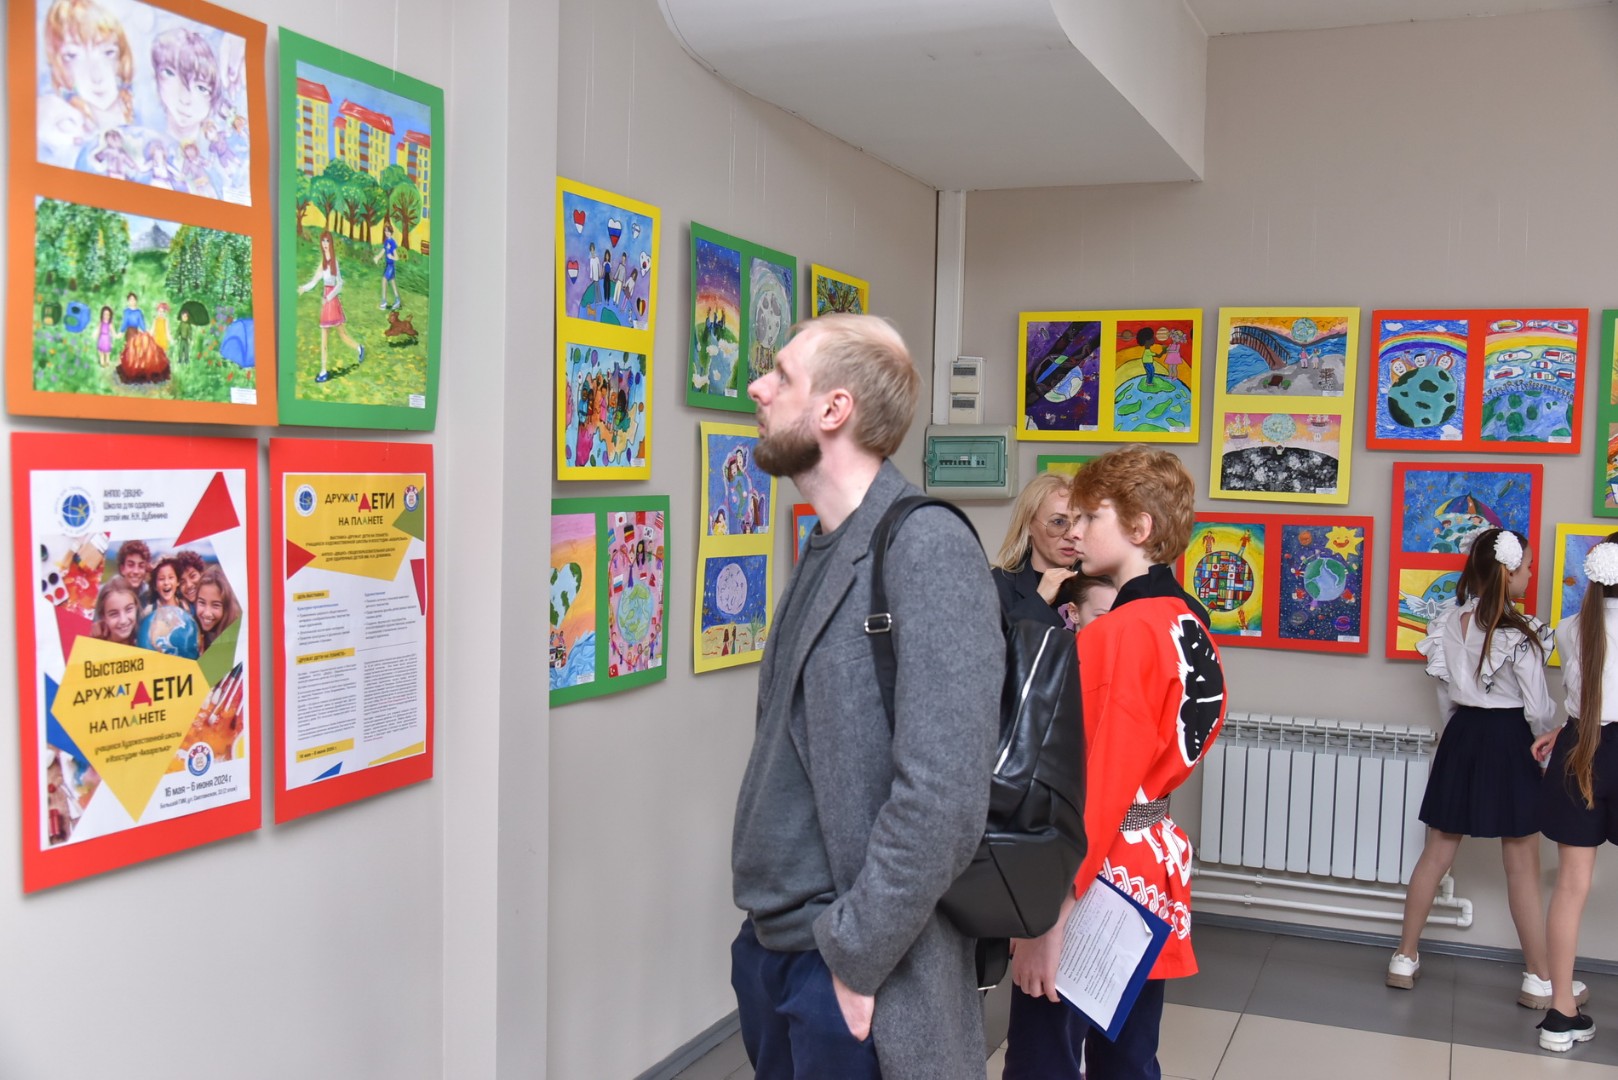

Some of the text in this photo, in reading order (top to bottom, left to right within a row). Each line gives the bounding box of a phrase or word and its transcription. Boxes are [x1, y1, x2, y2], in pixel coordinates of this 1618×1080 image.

[325, 493, 358, 505] ДРУЖАТ
[358, 492, 395, 513] ДЕТИ
[338, 516, 384, 526] НА ПЛАНЕТЕ
[84, 658, 144, 679] Выставка
[73, 674, 193, 710] ДРУЖАТ ДЕТИ
[90, 709, 166, 734] НА ПЛАНЕТЕ
[165, 787, 171, 797] 16
[172, 786, 186, 796] мая
[191, 781, 196, 791] 6
[196, 780, 213, 790] июня
[214, 774, 228, 786] 2024
